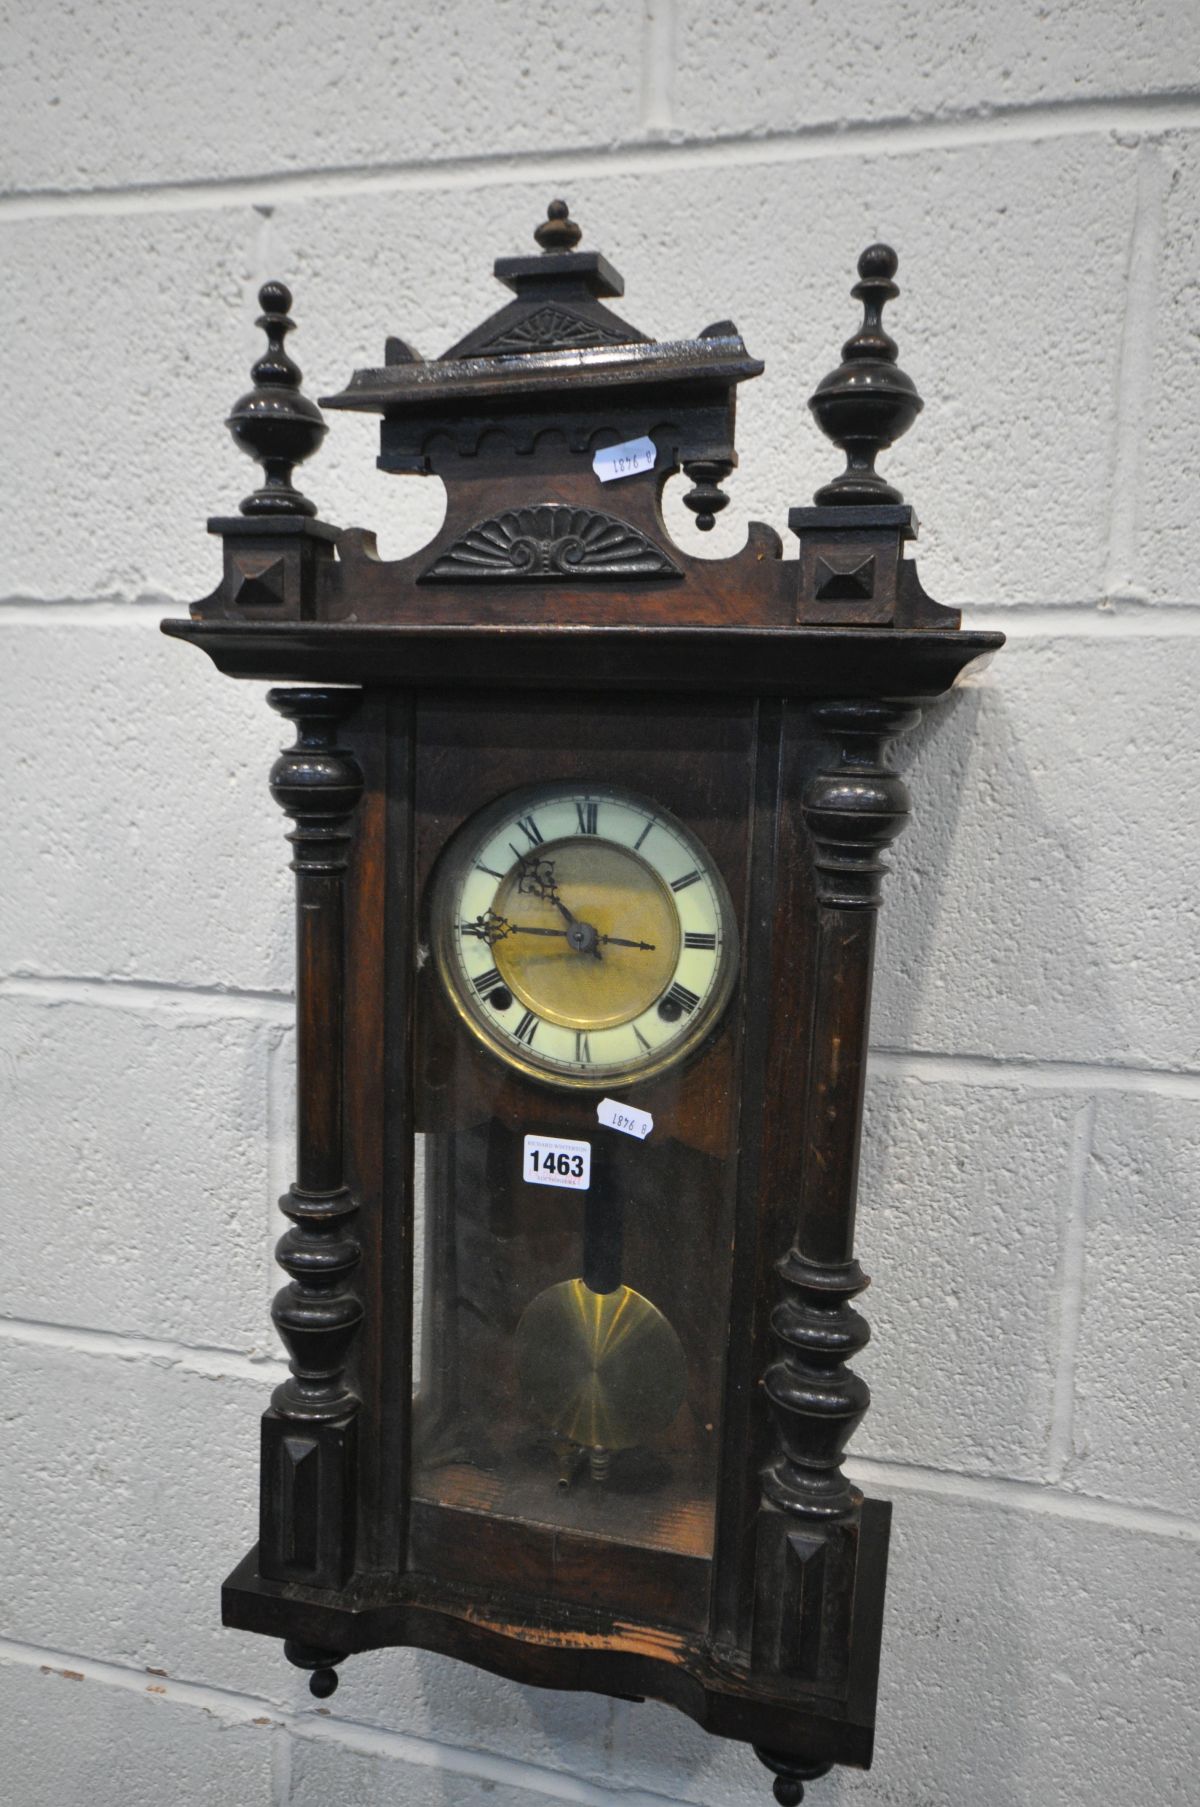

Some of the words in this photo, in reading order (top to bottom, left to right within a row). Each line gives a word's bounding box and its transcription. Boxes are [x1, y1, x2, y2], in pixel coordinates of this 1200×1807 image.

[575, 802, 599, 835] XII
[670, 869, 702, 893] II
[684, 932, 716, 951] III
[514, 1012, 540, 1046] VII
[575, 1031, 591, 1063] VI
[530, 1149, 584, 1178] 1463
